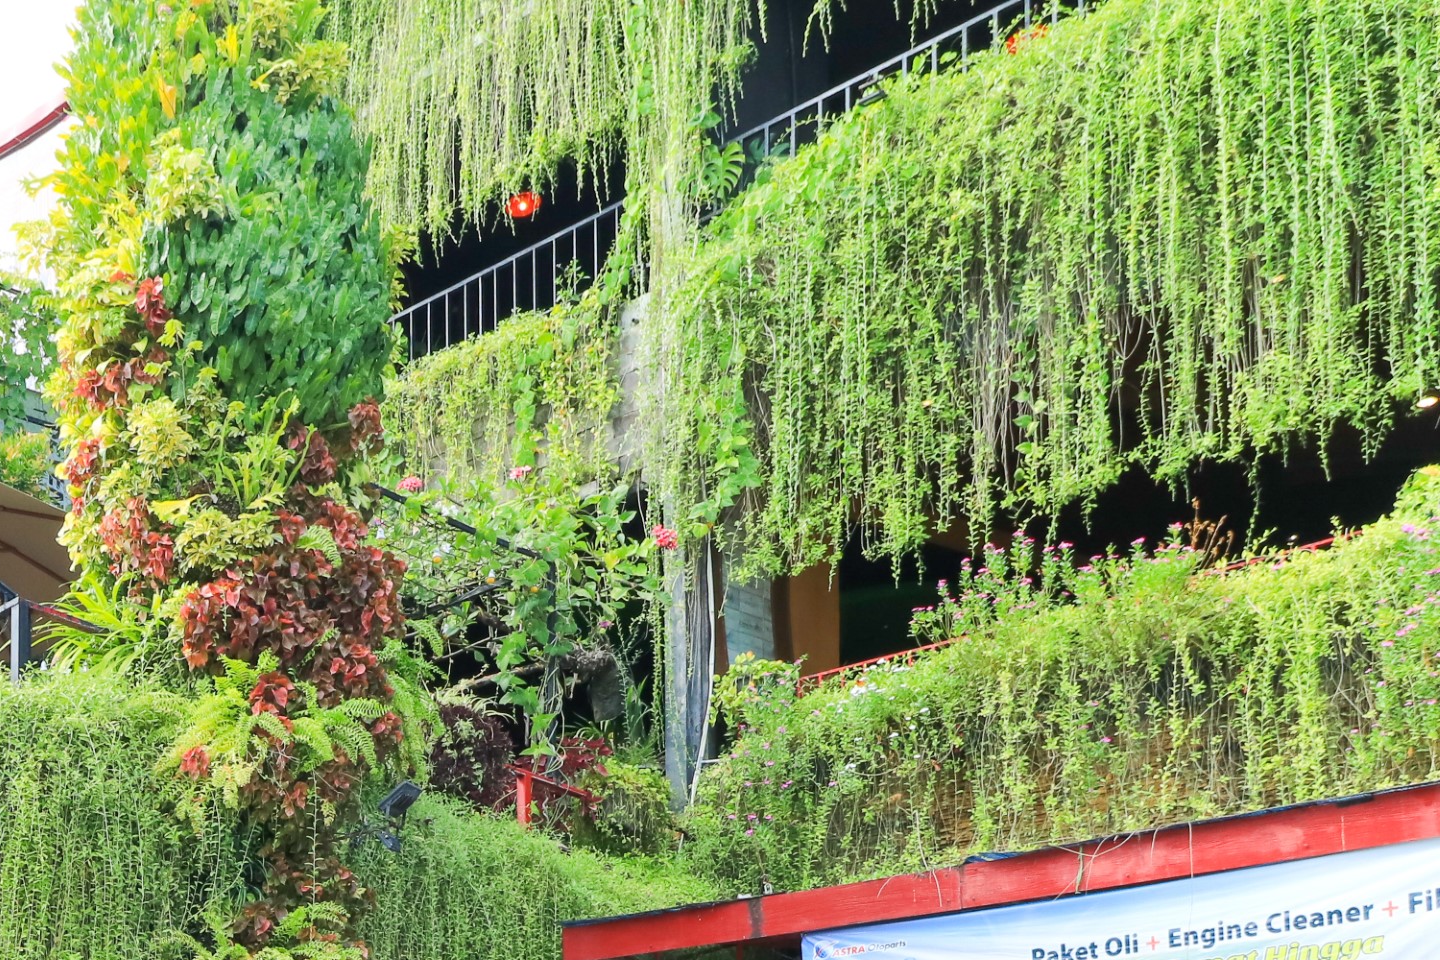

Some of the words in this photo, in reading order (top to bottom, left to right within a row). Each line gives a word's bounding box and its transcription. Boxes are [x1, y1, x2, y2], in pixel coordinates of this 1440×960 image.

[1105, 932, 1139, 957] Oli
[1168, 921, 1258, 949] Engine
[1266, 901, 1374, 934] Cleaner
[833, 945, 865, 957] ASTRA
[868, 940, 906, 951] Otoparts
